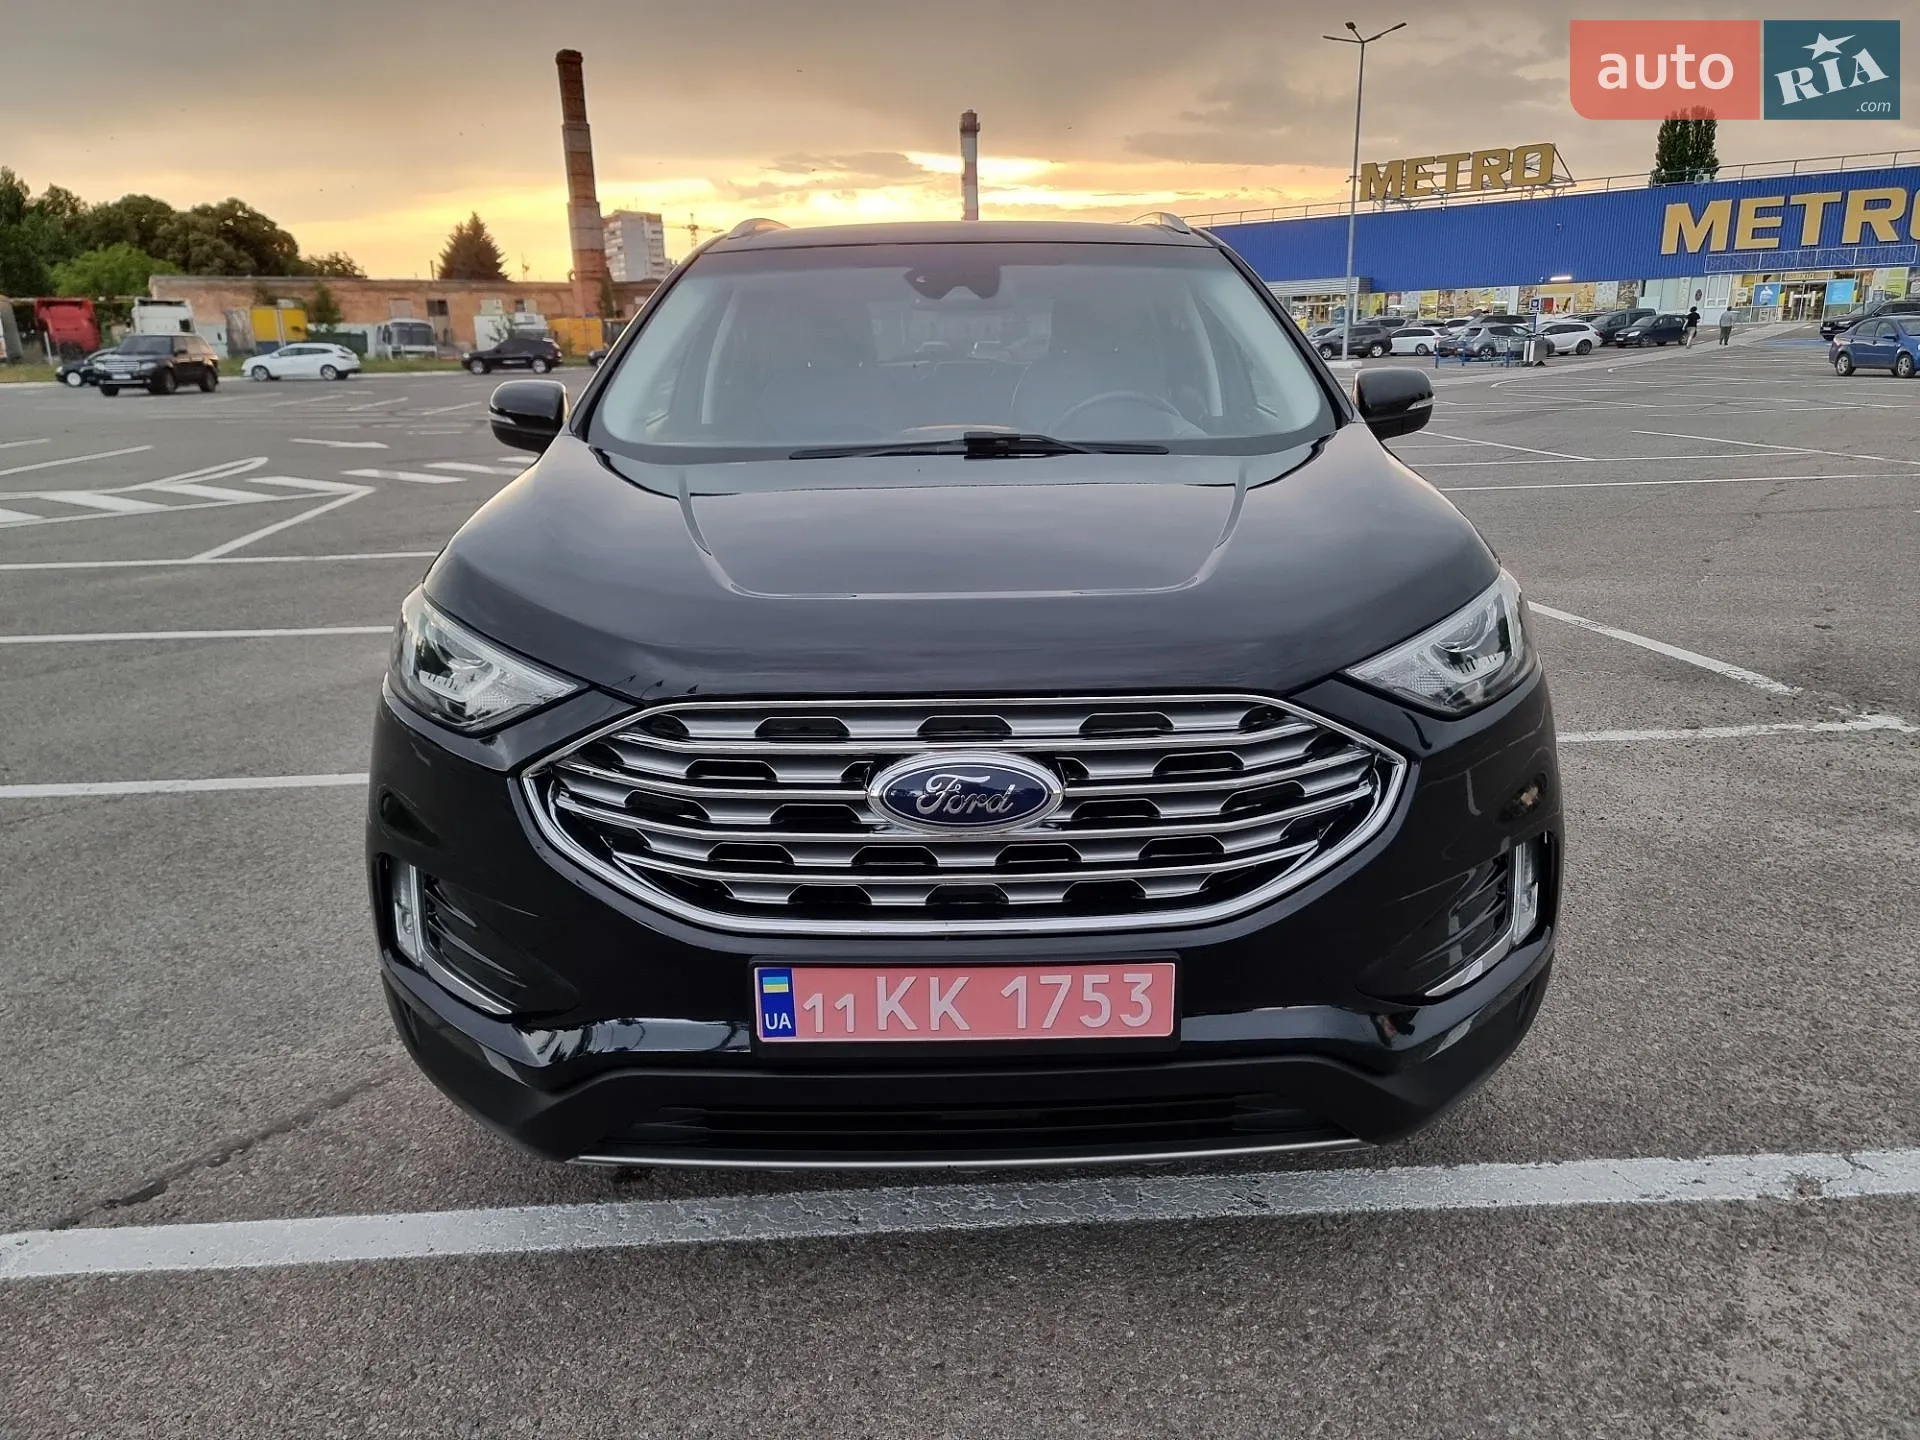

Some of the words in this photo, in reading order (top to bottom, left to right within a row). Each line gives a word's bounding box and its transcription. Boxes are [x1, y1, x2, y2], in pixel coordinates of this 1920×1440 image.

[1360, 142, 1556, 201] METRO
[1660, 187, 1920, 255] METR
[916, 773, 1016, 815] Ford
[765, 1013, 792, 1029] UA
[802, 993, 856, 1033] 11
[876, 976, 971, 1031] KK
[1000, 973, 1153, 1029] 1753
